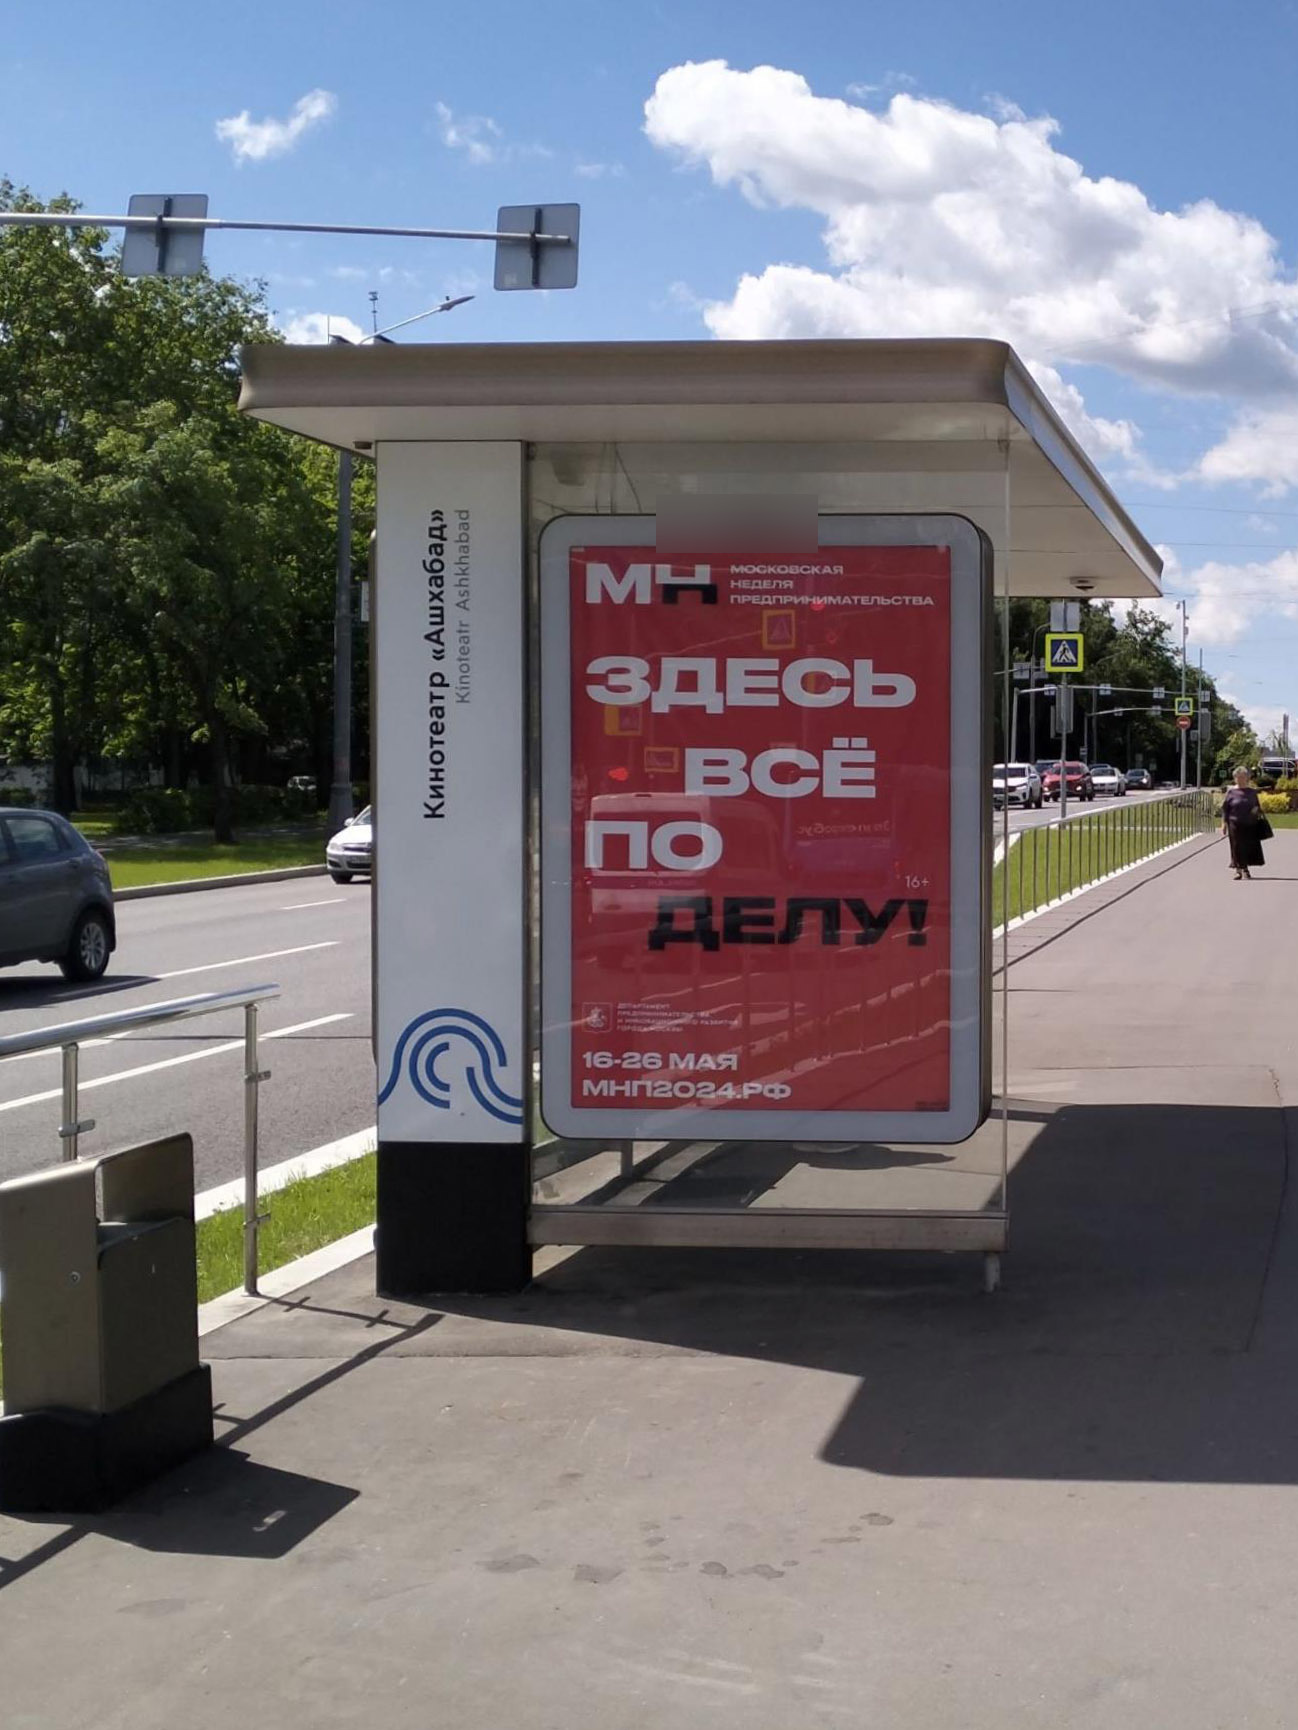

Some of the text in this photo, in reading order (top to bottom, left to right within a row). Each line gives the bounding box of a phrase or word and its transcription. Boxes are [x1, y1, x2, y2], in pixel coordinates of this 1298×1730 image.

[730, 565, 844, 575] МОСКОВСКАЯ
[730, 580, 794, 590] НЕДЕЛЯ
[454, 509, 471, 704] Kinoteatr Ashkhabad
[730, 595, 934, 606] ПРЕДПРИНИМАТЕЛЬСТВА
[423, 509, 450, 819] Кинотеатр «Ашхабад»
[586, 656, 917, 714] ЗДЕСЬ
[684, 737, 877, 799] ВСЁ
[584, 820, 724, 871] ПО
[905, 875, 930, 888] 16+
[648, 896, 930, 951] ДЕЛУ!
[582, 1051, 738, 1071] 16-26 МАЯ
[582, 1080, 792, 1100] МНП2024.РФ
